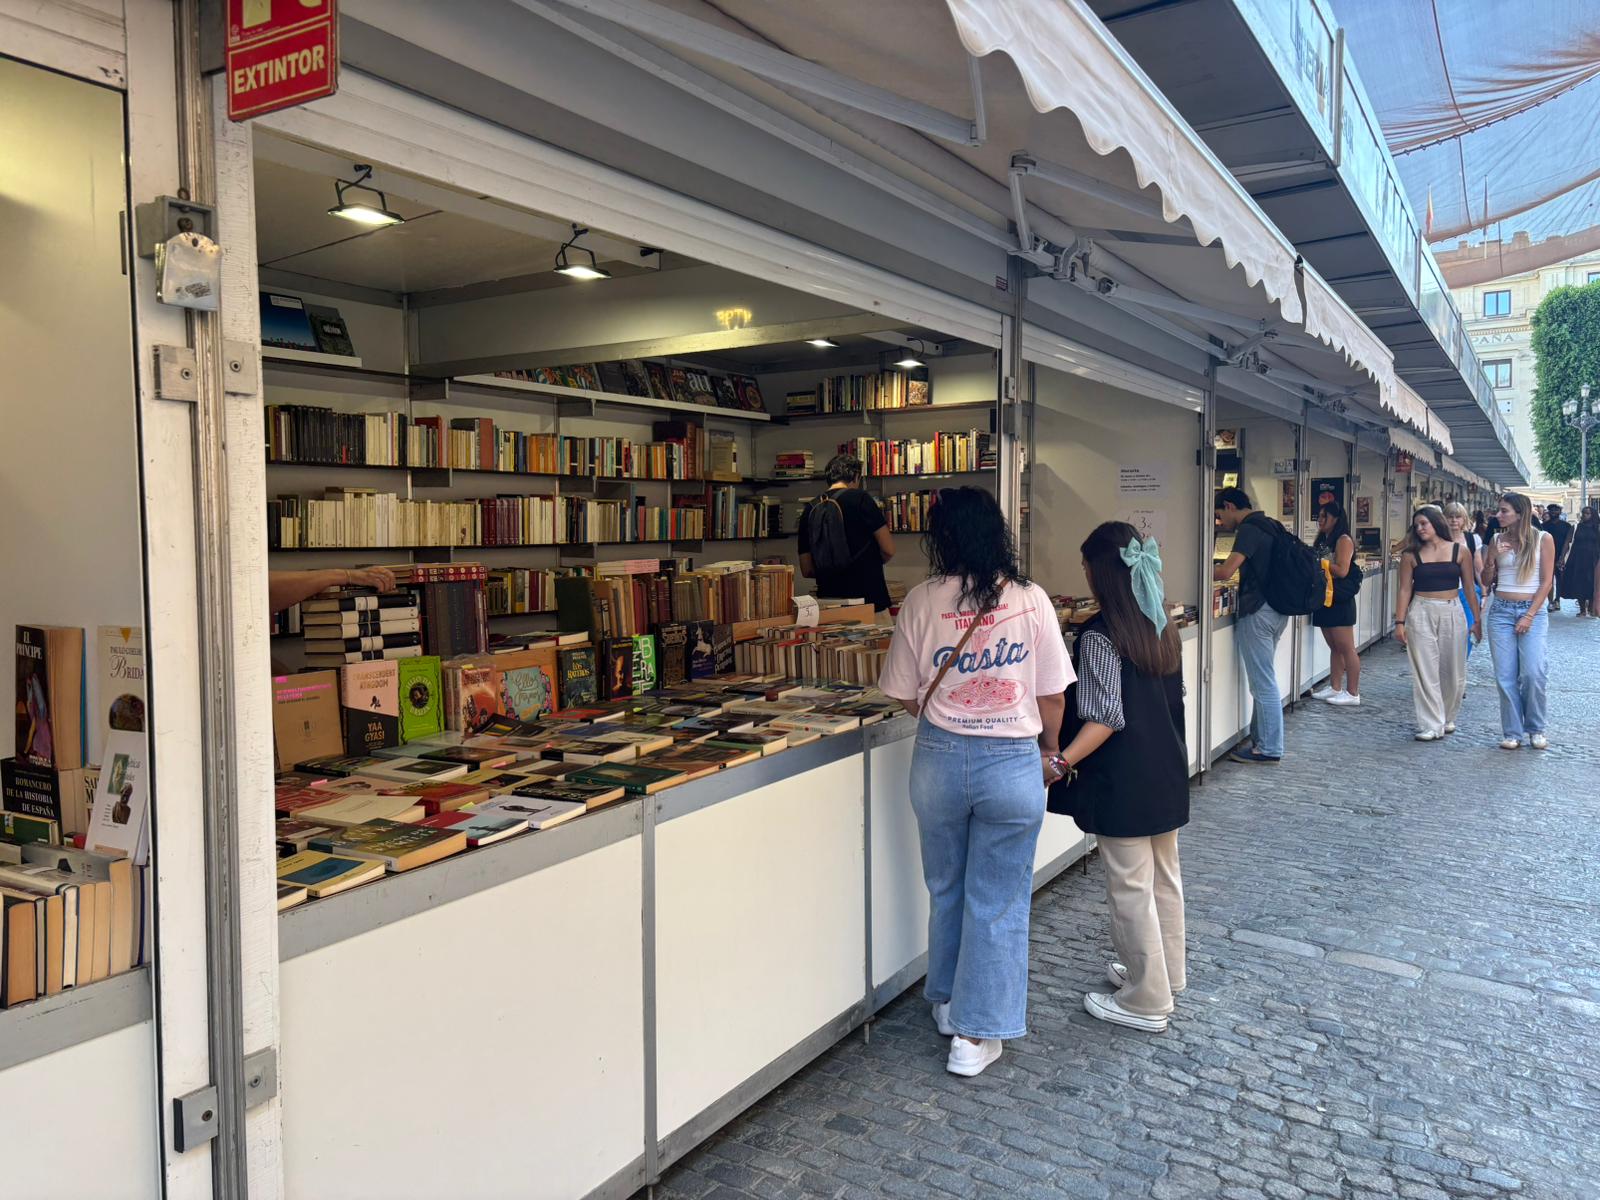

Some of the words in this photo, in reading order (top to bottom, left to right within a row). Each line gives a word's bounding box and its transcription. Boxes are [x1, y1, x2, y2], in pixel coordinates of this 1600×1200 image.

[233, 45, 325, 94] EXTINTOR
[1471, 333, 1514, 345] PAÑA
[23, 631, 32, 644] EL
[933, 637, 1029, 674] Pasta
[367, 721, 383, 732] YAA
[947, 716, 983, 724] PREMIUM
[985, 716, 1018, 725] QUALITY
[364, 730, 385, 743] GYASI
[15, 776, 52, 792] ROMANCERO
[6, 788, 15, 797] DE
[15, 789, 24, 799] LA
[24, 790, 53, 805] HISTORIA
[22, 803, 32, 814] DE
[31, 805, 56, 818] ESPAÑA
